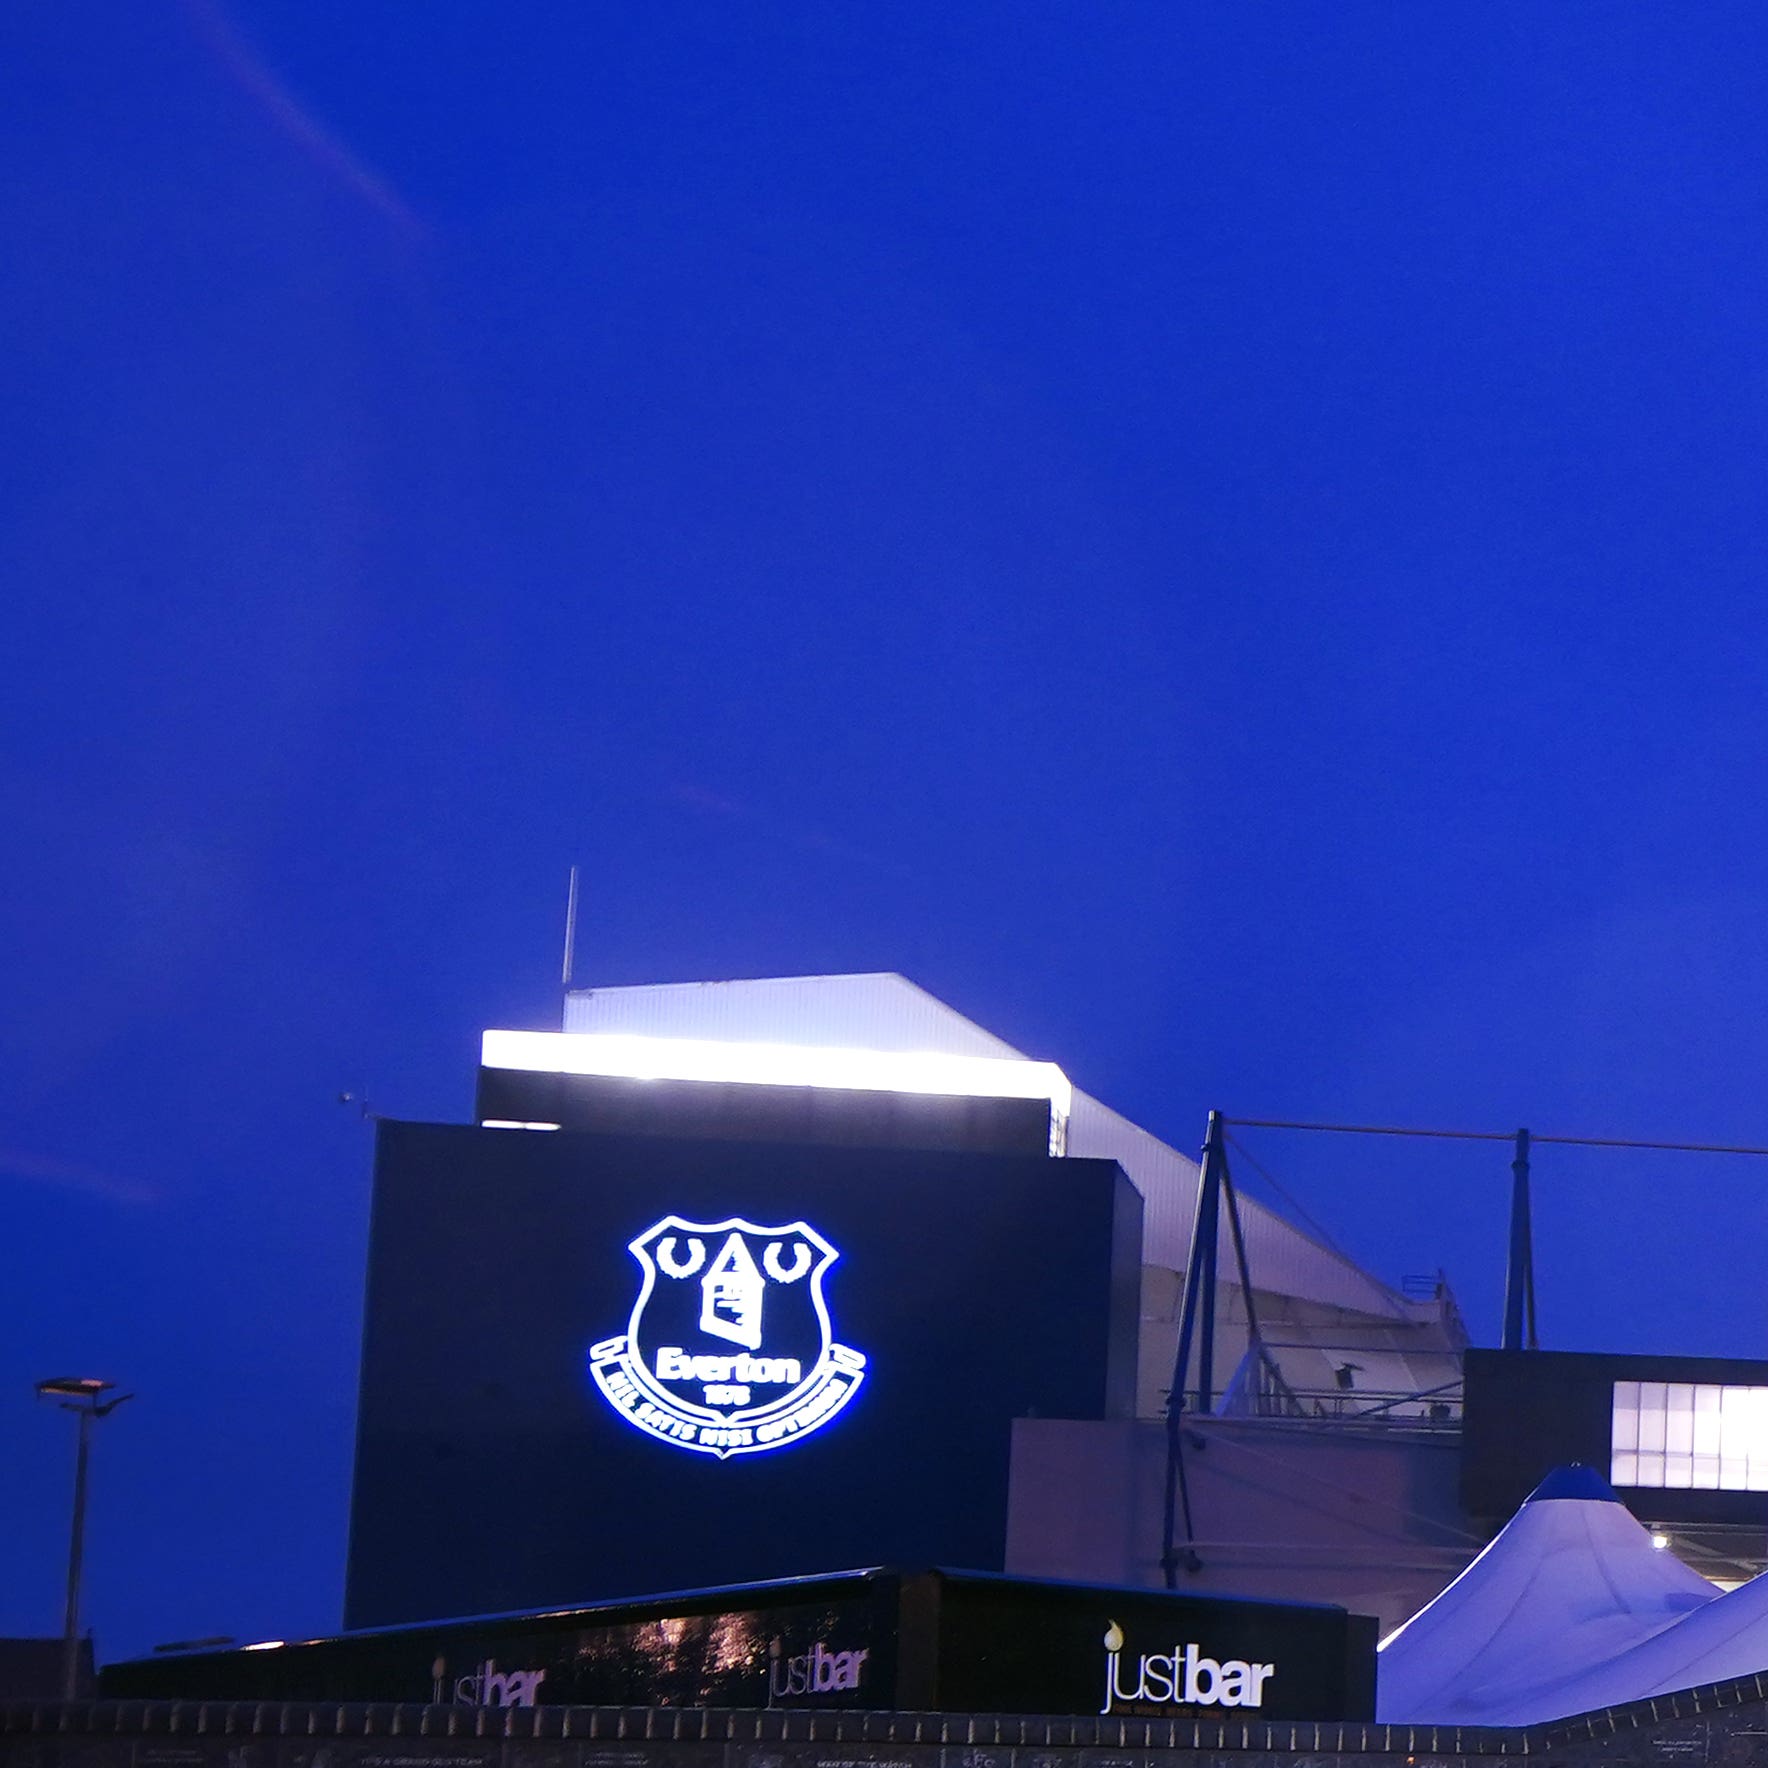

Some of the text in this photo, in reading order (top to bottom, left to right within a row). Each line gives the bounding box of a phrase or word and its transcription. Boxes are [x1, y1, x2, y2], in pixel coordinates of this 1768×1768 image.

[656, 1347, 801, 1383] Everton
[767, 1640, 872, 1708] justbar
[1099, 1641, 1276, 1717] justbar
